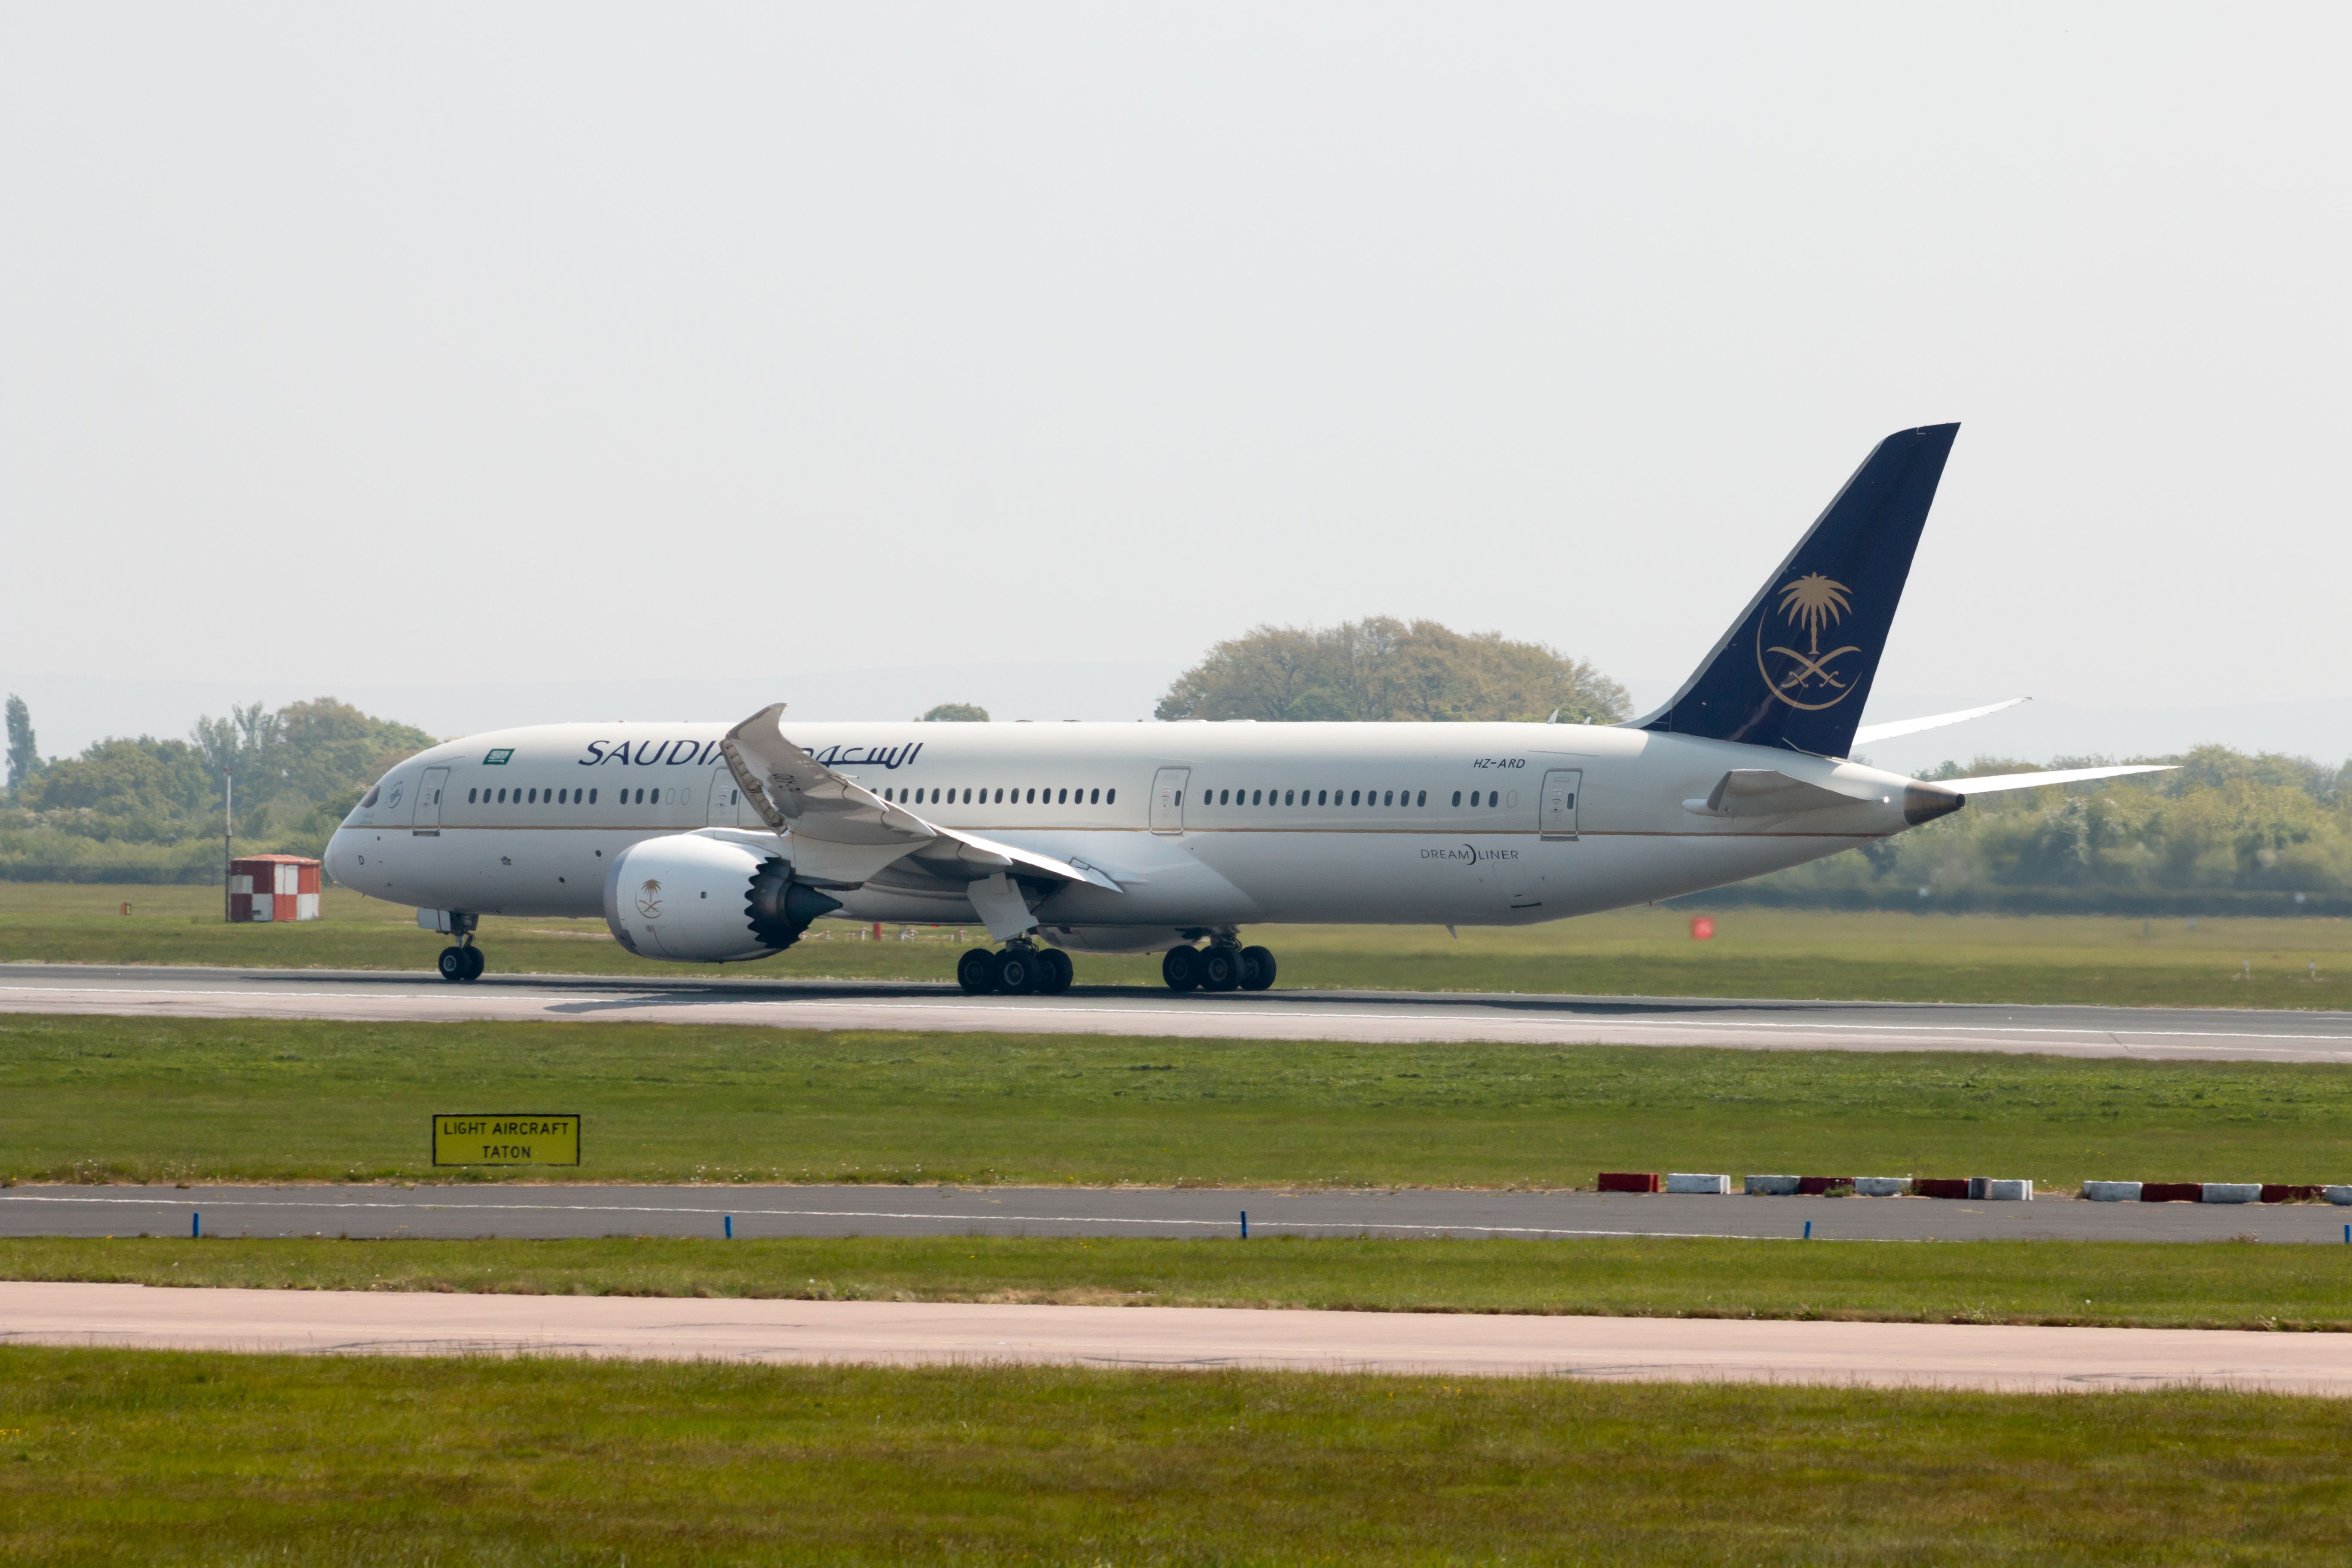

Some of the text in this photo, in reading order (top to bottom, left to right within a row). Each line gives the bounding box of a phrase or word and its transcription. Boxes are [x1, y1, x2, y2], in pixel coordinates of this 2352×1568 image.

[1473, 759, 1525, 769] HZ-ARD
[444, 1122, 569, 1135] LIGHT AIRCRAFT
[482, 1145, 531, 1159] TATON
